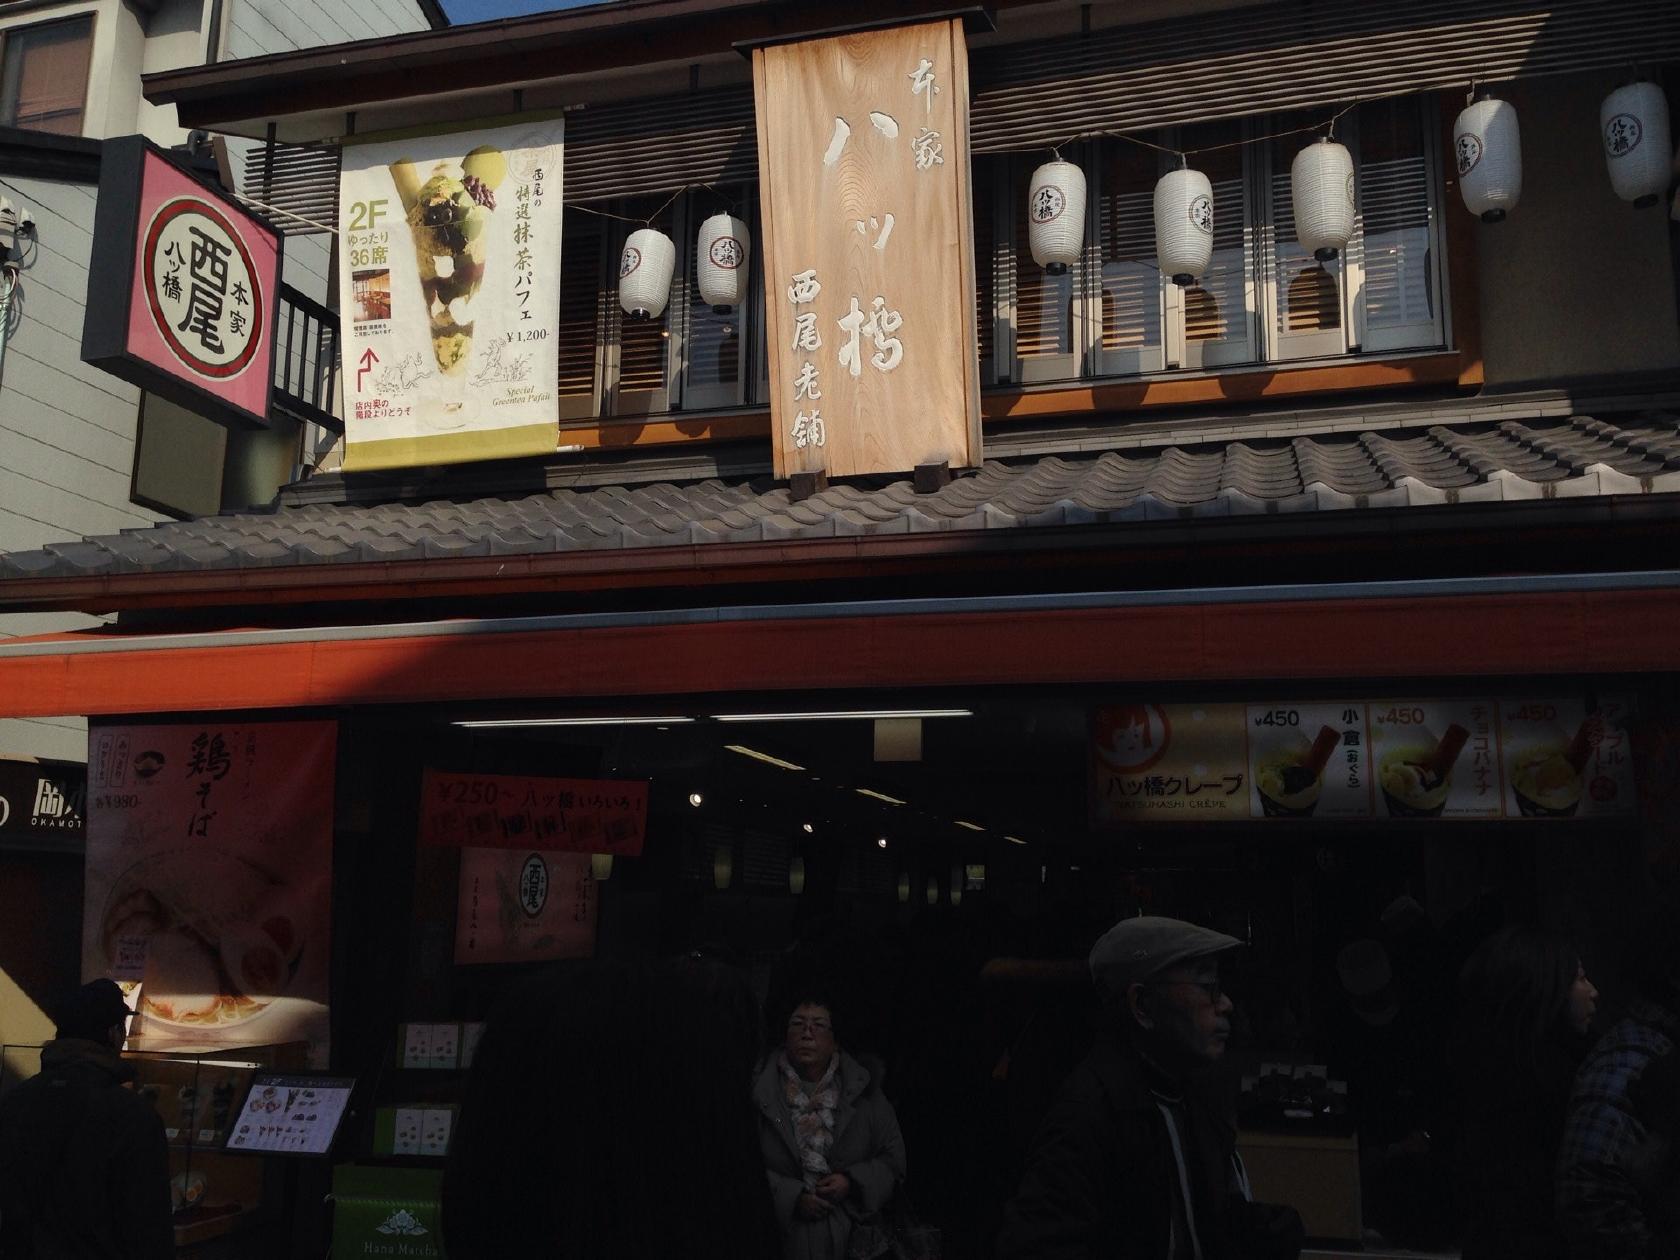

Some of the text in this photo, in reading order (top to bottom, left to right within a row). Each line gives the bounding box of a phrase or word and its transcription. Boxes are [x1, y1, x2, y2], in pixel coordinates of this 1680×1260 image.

[531, 168, 545, 208] 西尾の
[348, 198, 390, 232] 2F
[347, 231, 390, 248] ゆったり
[349, 246, 390, 267] 36席
[513, 184, 535, 321] 特選抹茶パフェ
[177, 225, 233, 355] 西尾
[229, 281, 250, 338] 本家
[355, 399, 390, 411] 店内奥の
[355, 406, 412, 420] 階段よりどうぞ
[1255, 710, 1300, 727] ¥450
[1377, 707, 1425, 725] ¥450
[1470, 704, 1493, 797] チョコバナナ
[186, 732, 231, 837] 鶏そば
